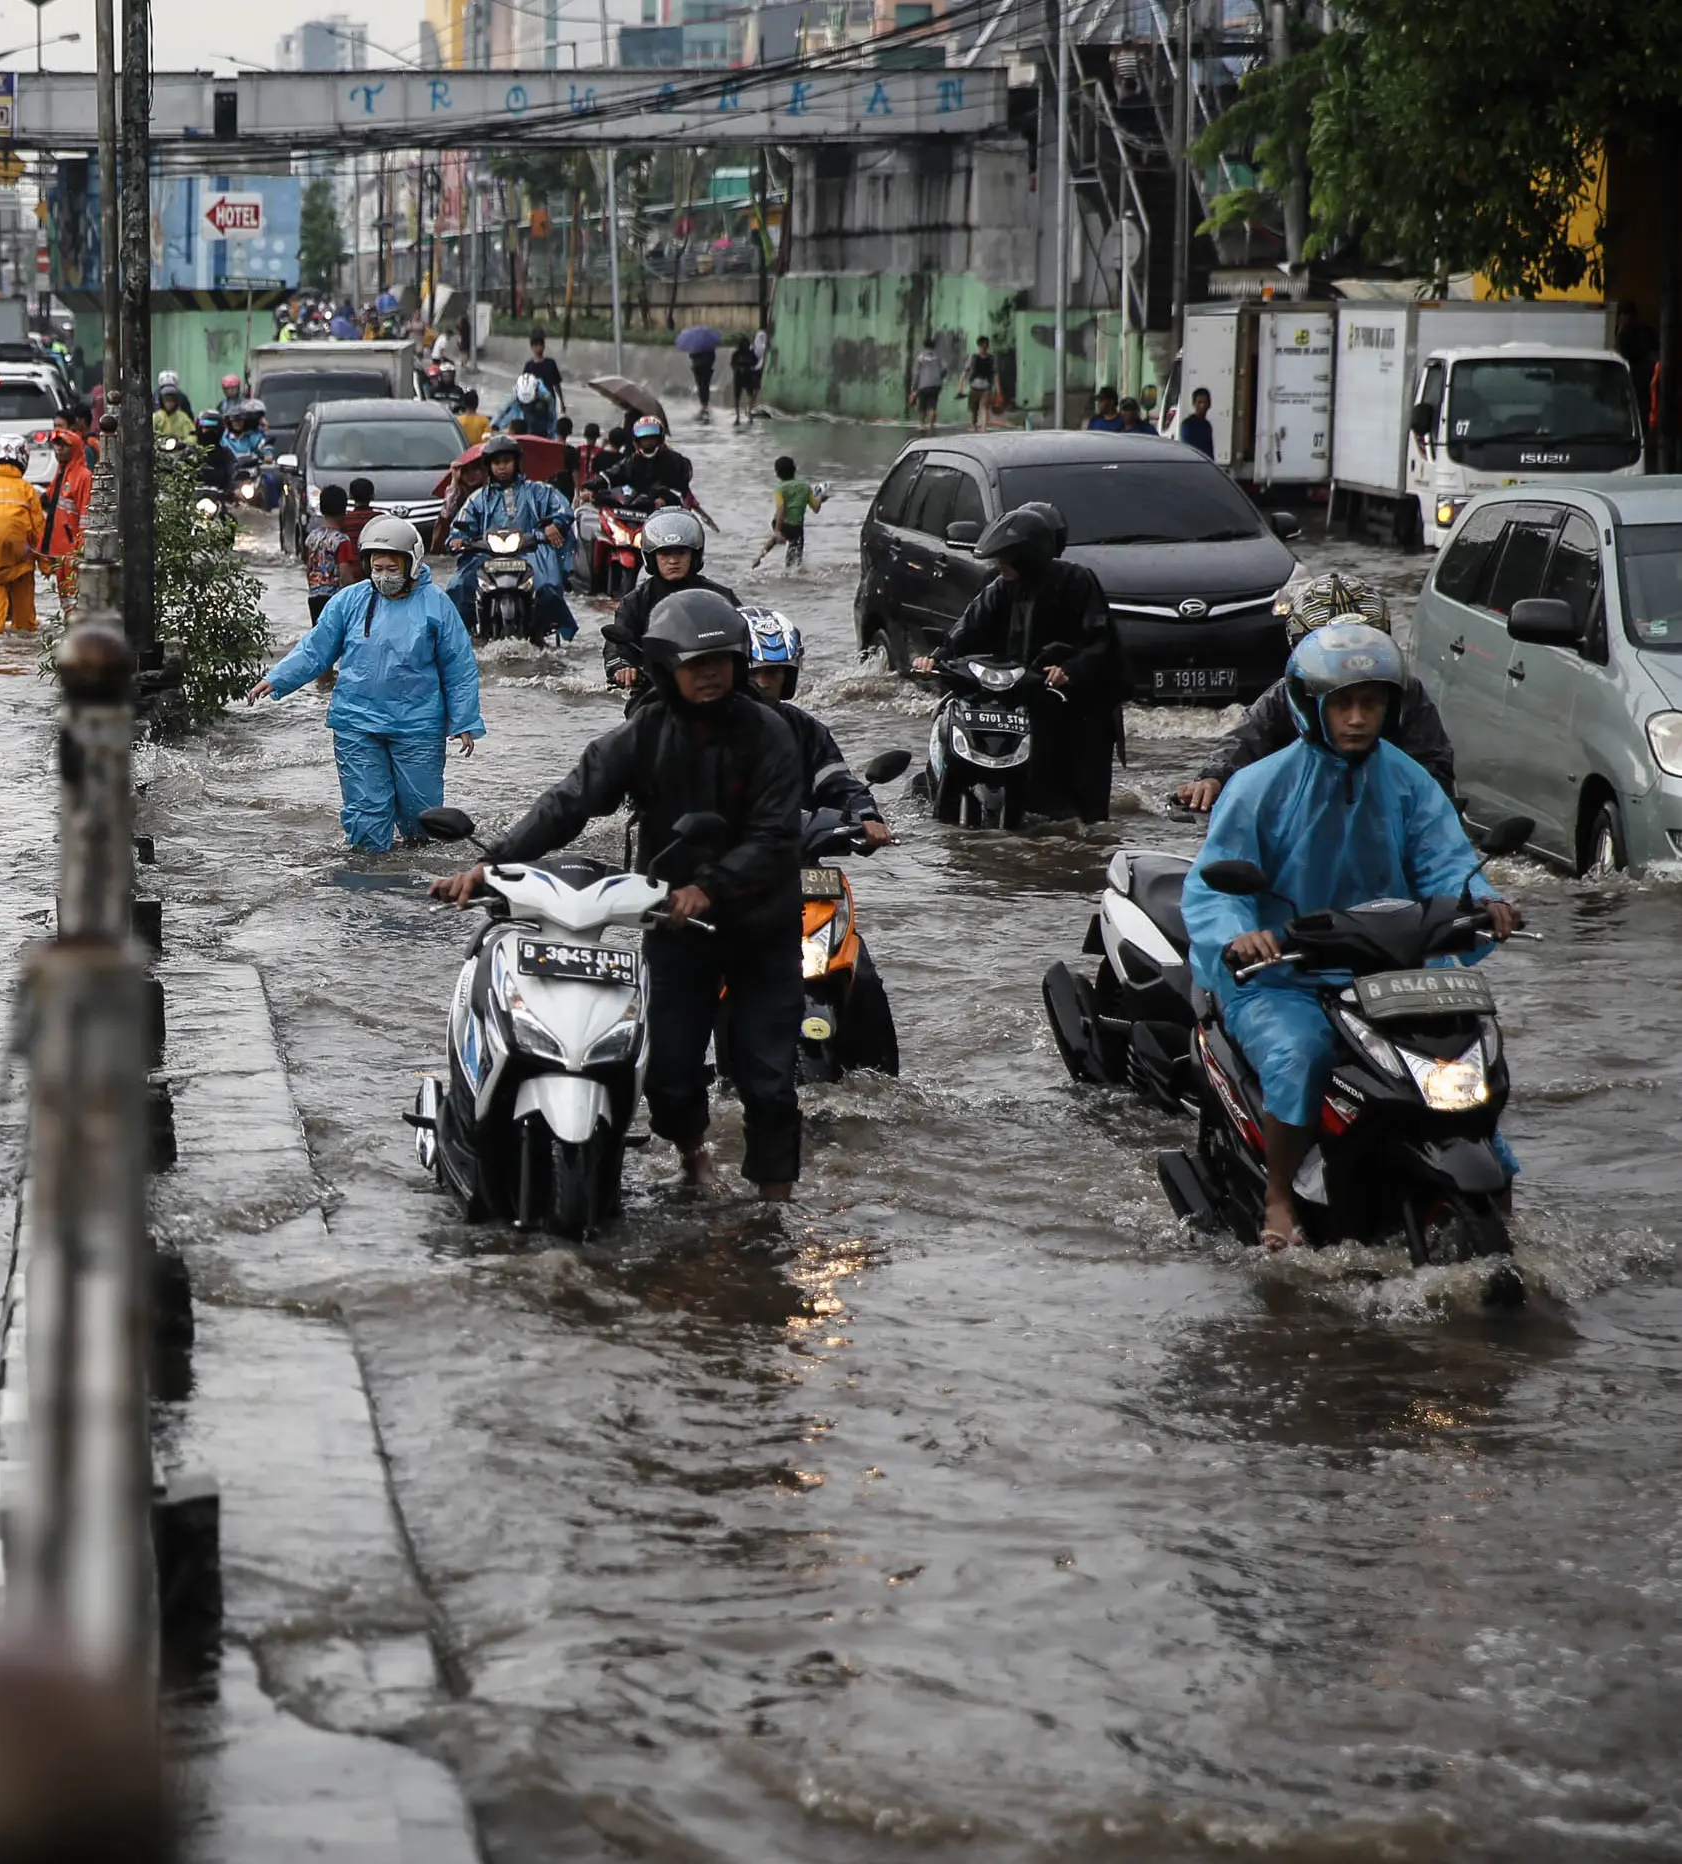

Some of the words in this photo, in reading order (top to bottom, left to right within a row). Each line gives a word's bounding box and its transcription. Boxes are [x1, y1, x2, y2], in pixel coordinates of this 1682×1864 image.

[216, 206, 258, 227] HOTEL
[1456, 420, 1470, 436] 07
[1520, 452, 1570, 465] ISUZU
[1156, 672, 1164, 688] B
[1175, 671, 1206, 687] 1918
[964, 712, 972, 722] B
[978, 713, 1001, 723] 6701
[524, 944, 535, 959] B
[1332, 1075, 1366, 1103] HONDA
